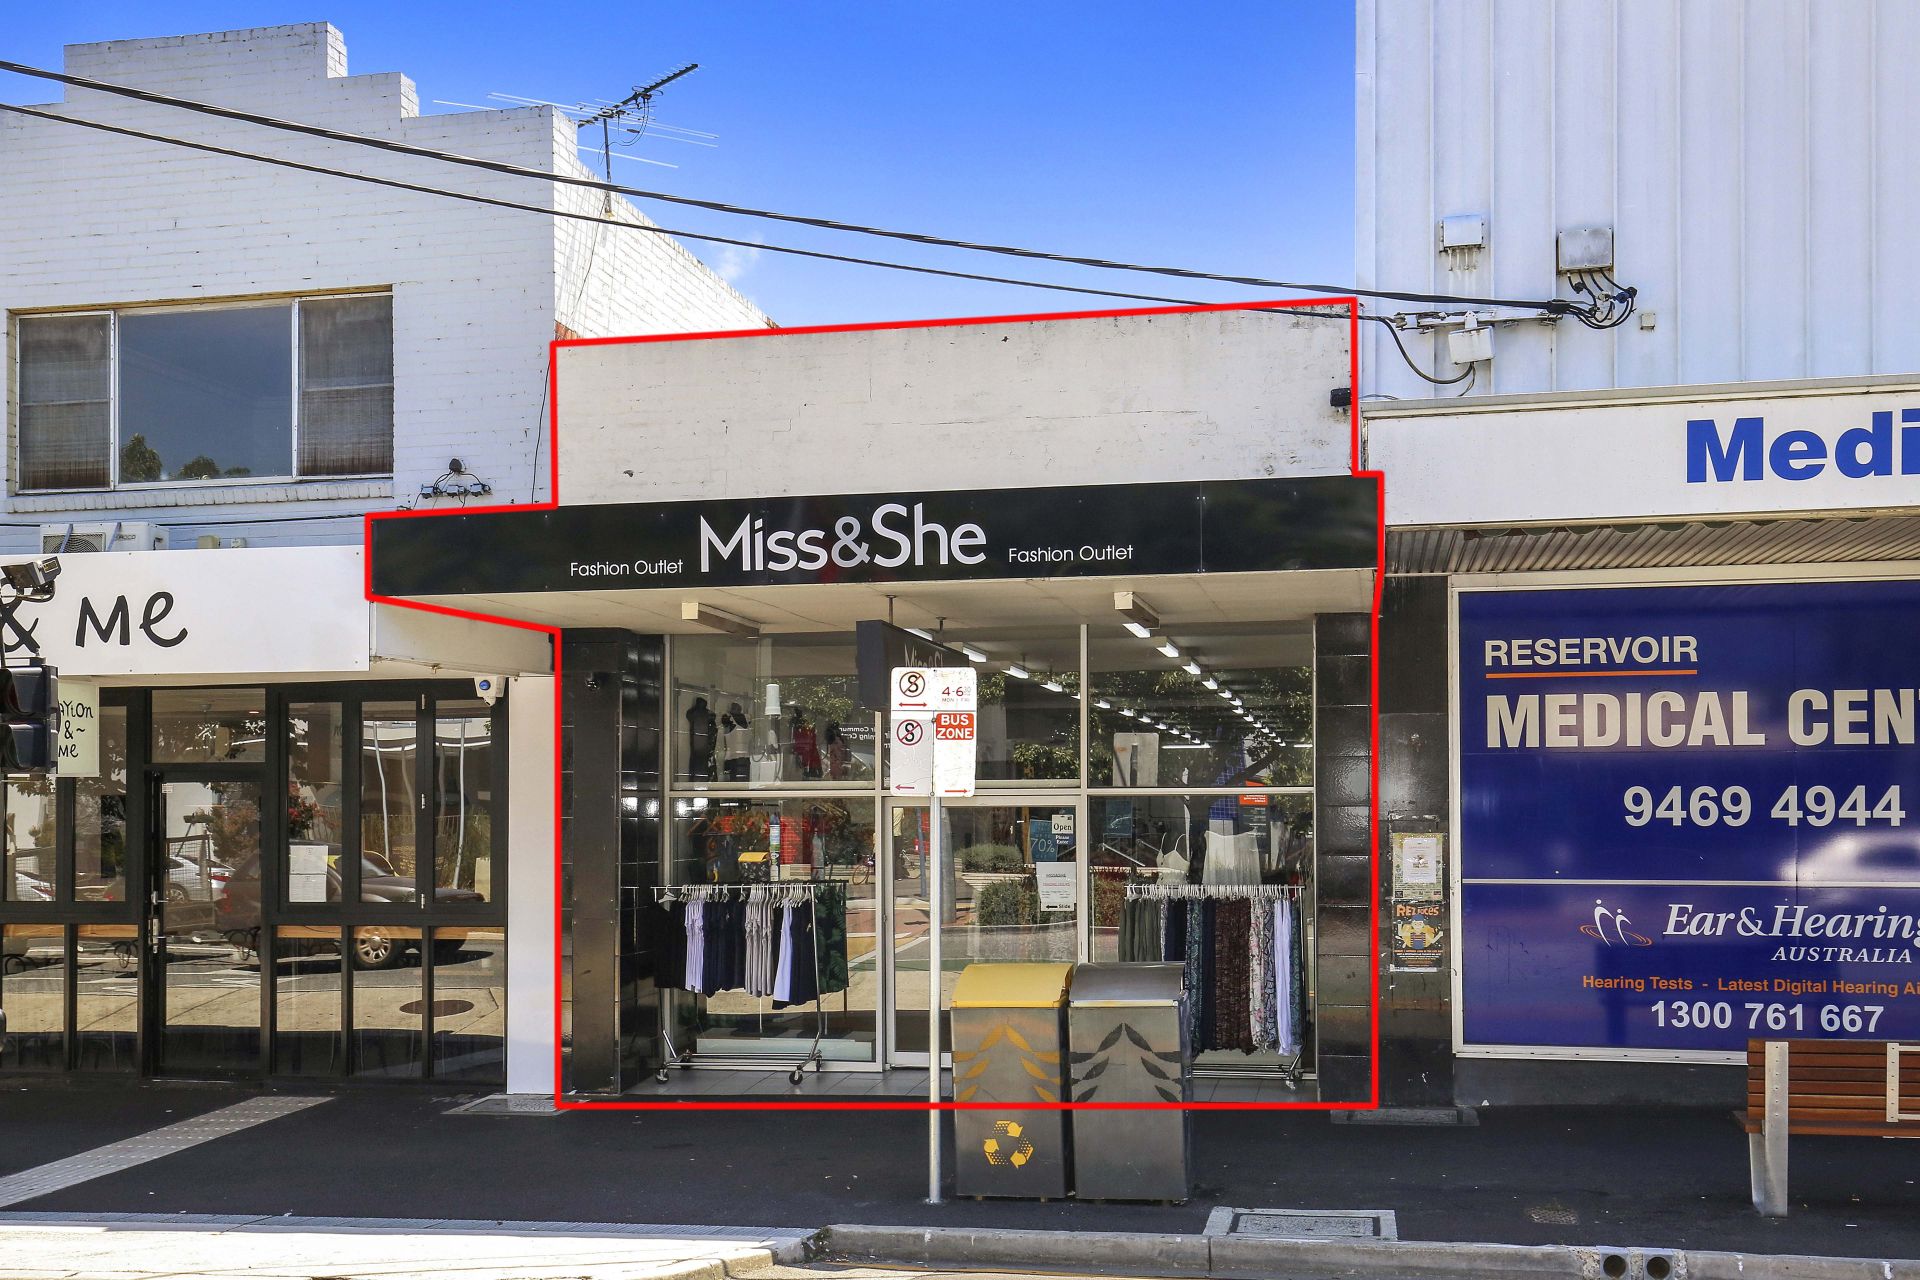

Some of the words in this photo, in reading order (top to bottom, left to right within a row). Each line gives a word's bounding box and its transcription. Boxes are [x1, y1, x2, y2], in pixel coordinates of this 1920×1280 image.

[700, 502, 987, 573] Miss&She
[1009, 546, 1074, 562] Fashion
[1079, 544, 1133, 561] Outlet
[570, 561, 629, 576] Fashion
[634, 559, 683, 574] Outlet
[1485, 635, 1698, 666] RESERVOIR
[941, 714, 969, 725] BUS
[1486, 691, 1766, 748] MEDICAL
[1788, 689, 1920, 746] CEN
[64, 720, 73, 739] &
[937, 728, 973, 739] ZONE
[1624, 785, 1751, 827] 9469
[1770, 784, 1906, 827] 4944
[1053, 823, 1072, 832] Open
[1030, 837, 1055, 853] 70%
[1771, 946, 1912, 963] AUSTRALIA
[1583, 976, 1645, 993] Hearing
[1650, 976, 1693, 990] Tests
[1718, 978, 1769, 992] Latest
[1774, 979, 1827, 995] Digital
[1833, 980, 1898, 998] Hearing
[1651, 1000, 1732, 1029] 1300
[1744, 1003, 1803, 1031] 761
[1820, 1004, 1885, 1033] 667
